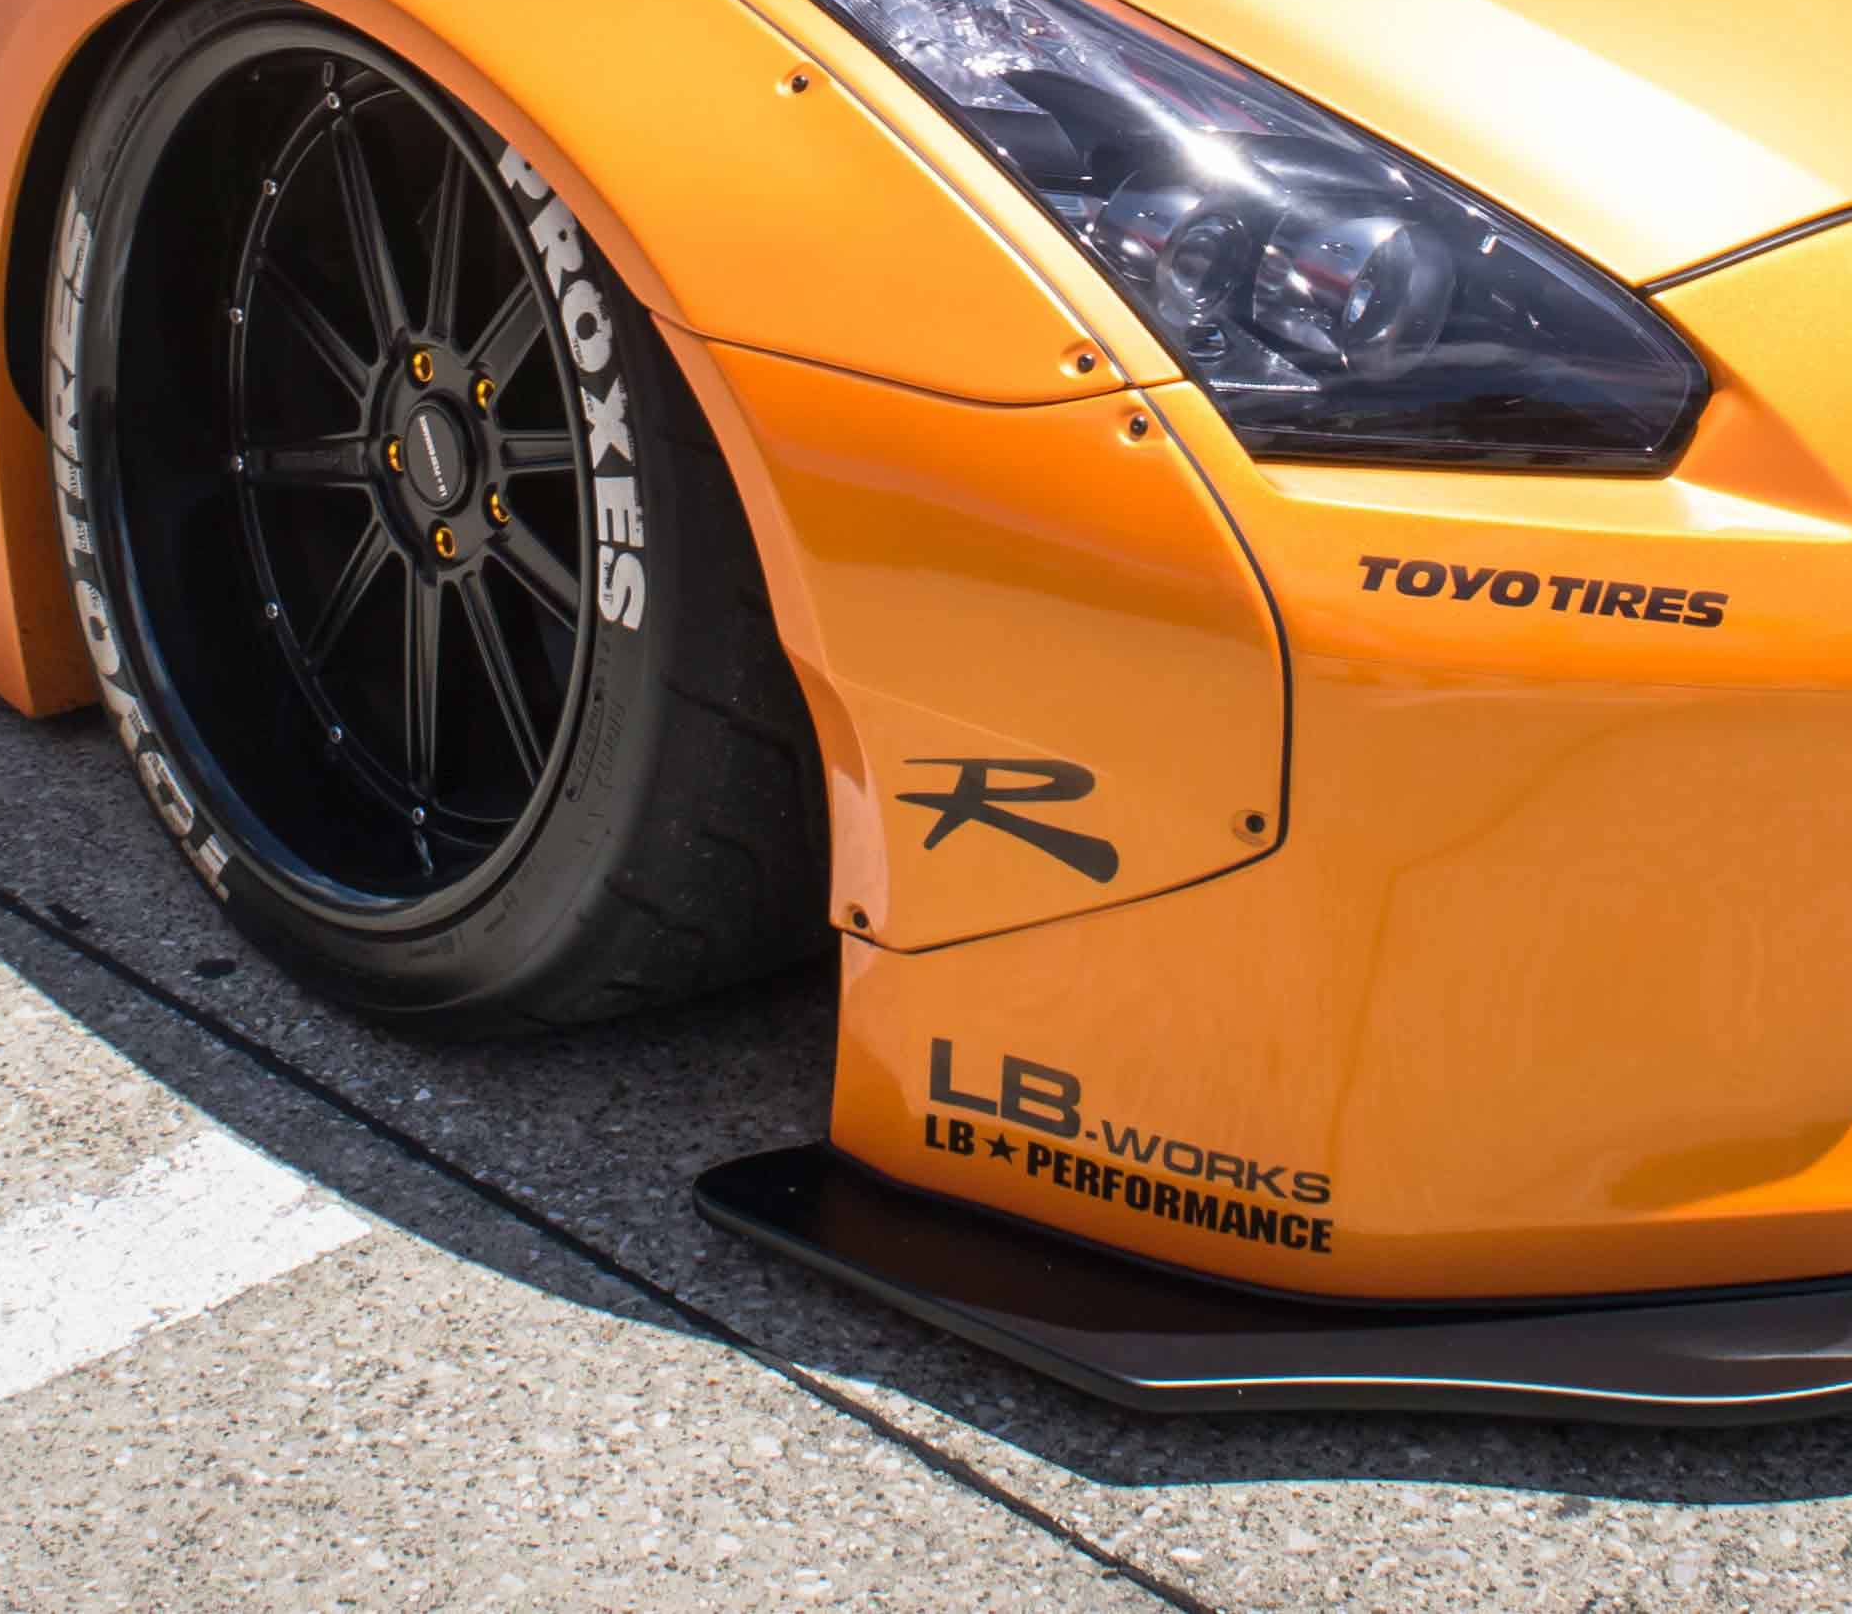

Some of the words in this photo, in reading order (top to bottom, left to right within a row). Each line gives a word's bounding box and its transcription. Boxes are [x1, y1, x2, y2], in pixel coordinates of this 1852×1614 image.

[497, 143, 646, 632] PROXES
[1356, 554, 1541, 611] TOYO
[1548, 574, 1729, 629] TIRES
[73, 579, 231, 904] TOYO
[923, 1112, 976, 1156] LB
[1027, 1140, 1335, 1255] PERFORMANCE
